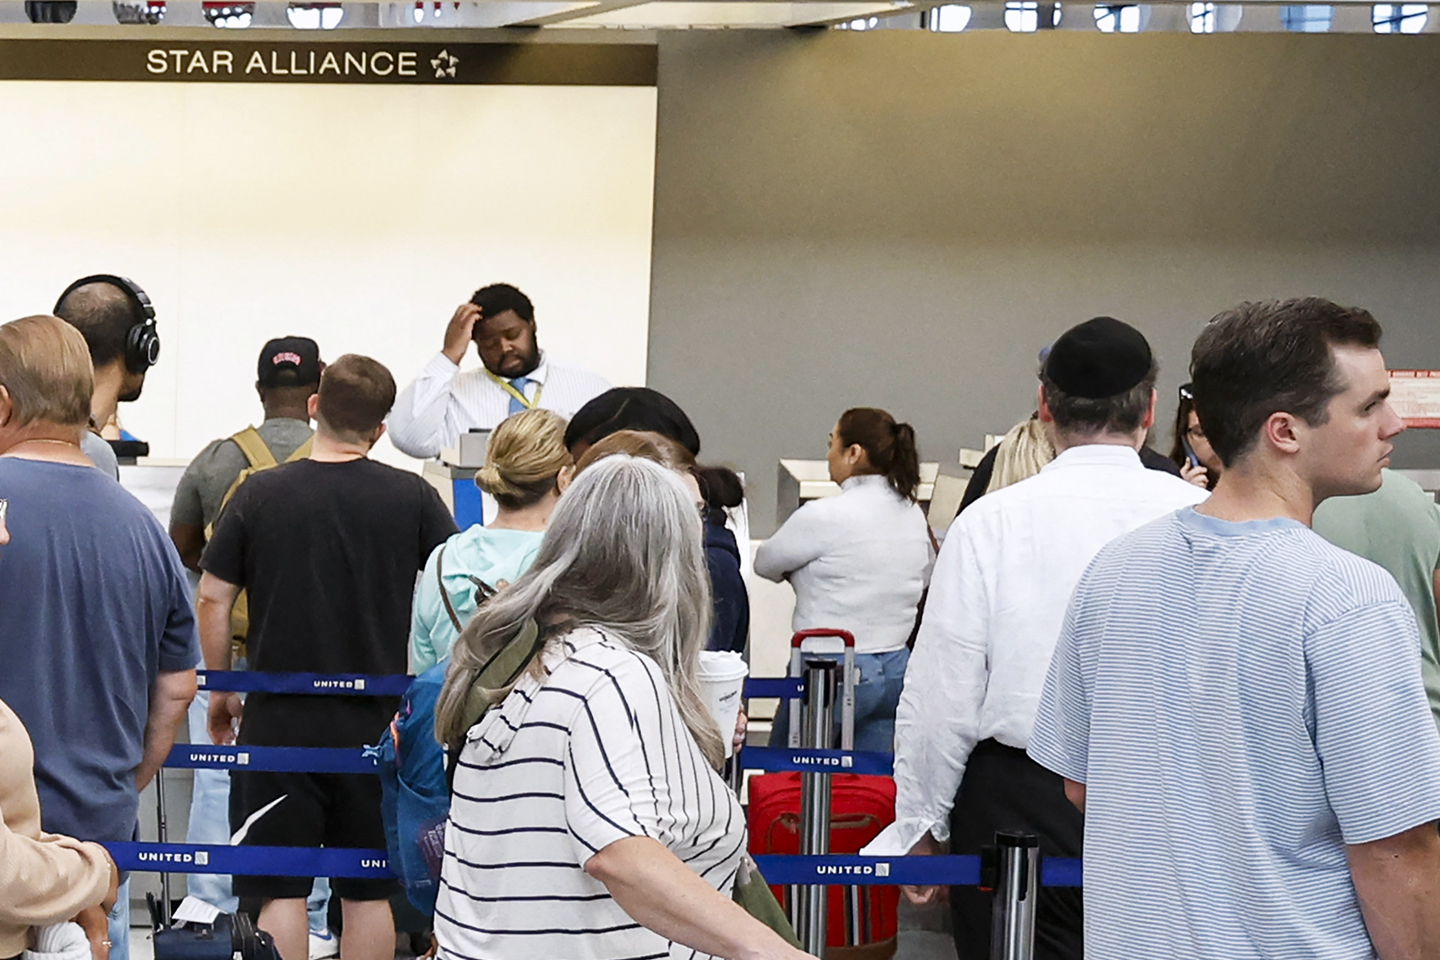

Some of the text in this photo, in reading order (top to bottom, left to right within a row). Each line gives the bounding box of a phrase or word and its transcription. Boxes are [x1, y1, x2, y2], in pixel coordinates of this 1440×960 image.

[146, 49, 417, 76] STAR ALLIANCE
[313, 680, 353, 688] UNITED
[190, 753, 236, 763] UNITED
[792, 756, 840, 766] UNITED
[138, 852, 193, 863] UNITED
[361, 859, 386, 868] UNI
[816, 865, 873, 875] UNITED
